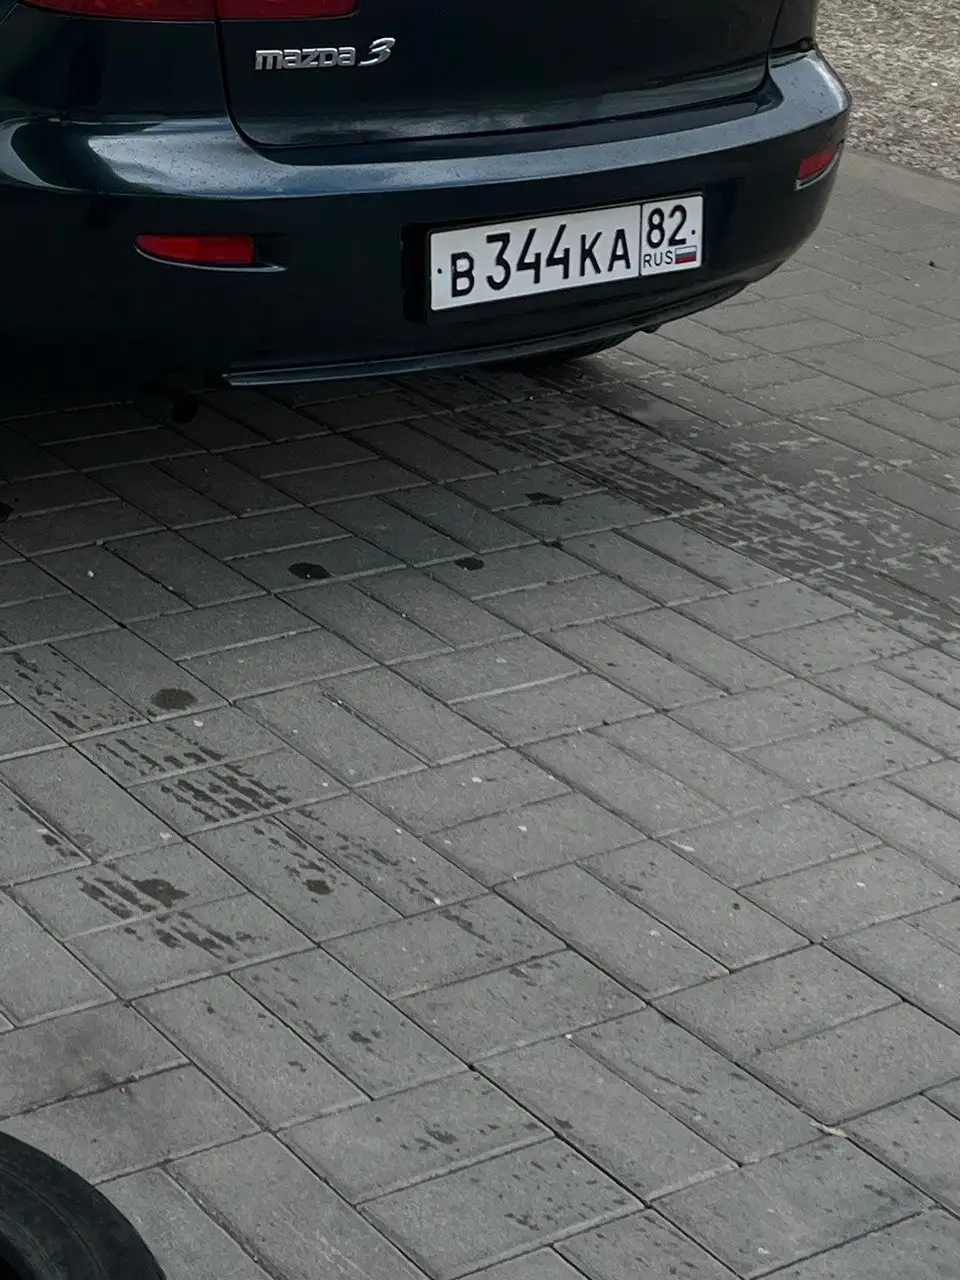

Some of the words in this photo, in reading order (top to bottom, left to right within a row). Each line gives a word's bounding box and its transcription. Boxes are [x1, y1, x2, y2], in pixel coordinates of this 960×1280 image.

[357, 37, 396, 67] 3
[450, 223, 632, 298] В344КА
[645, 204, 687, 249] 82
[642, 250, 674, 269] RUS
